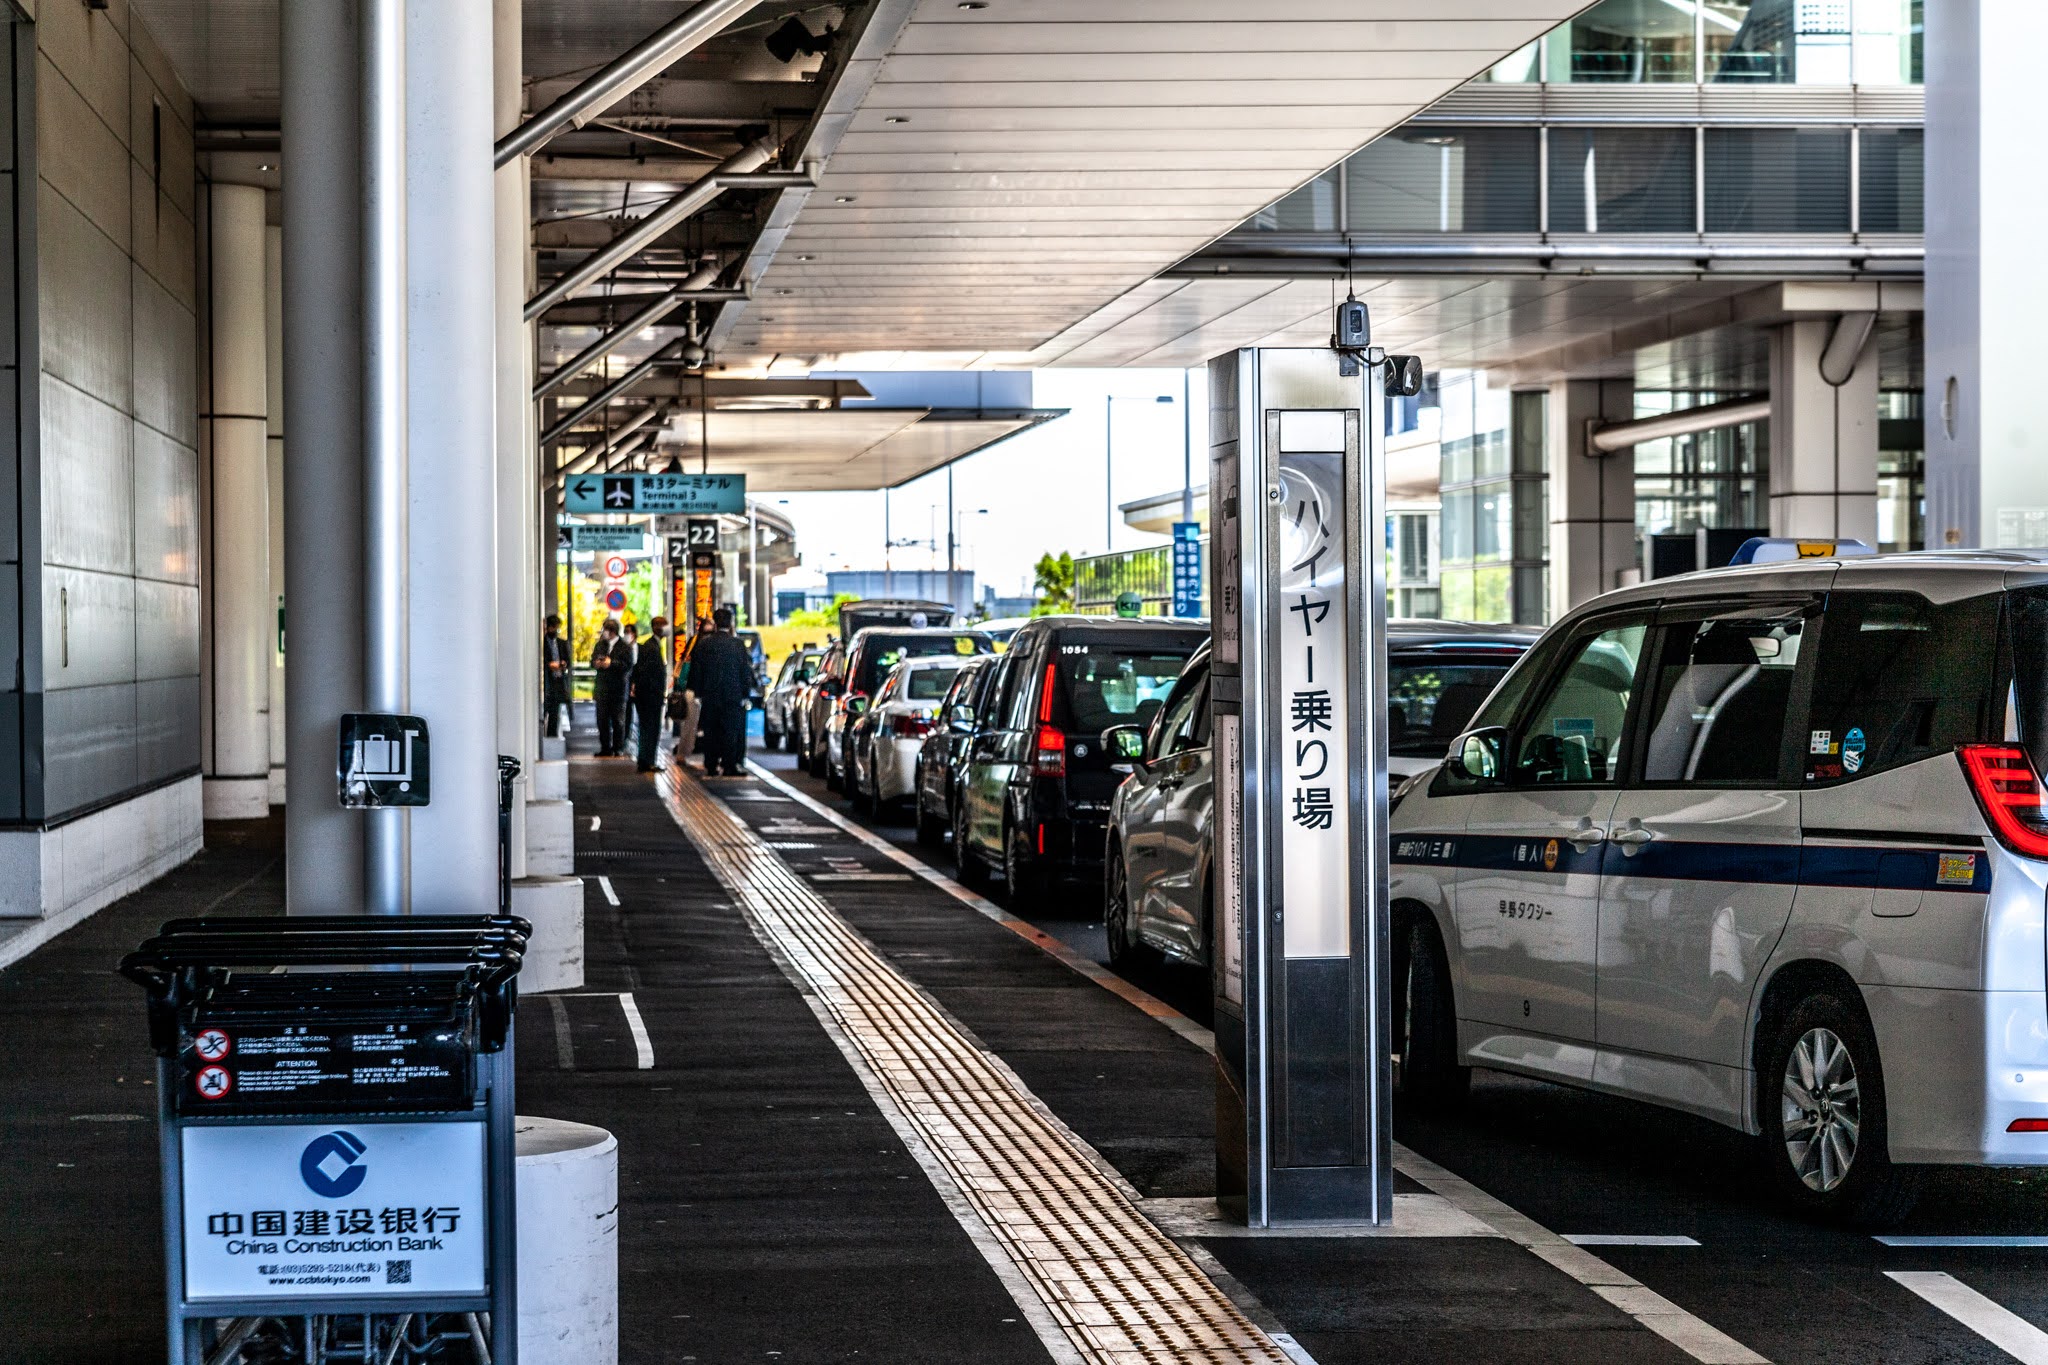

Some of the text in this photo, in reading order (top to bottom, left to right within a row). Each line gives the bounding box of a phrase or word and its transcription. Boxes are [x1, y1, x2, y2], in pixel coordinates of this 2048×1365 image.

[641, 478, 731, 490] 第3ターミナル
[642, 490, 697, 500] Terminal 3
[691, 526, 716, 545] 22
[671, 542, 688, 558] 2
[1062, 646, 1089, 654] 1054
[1290, 500, 1334, 831] ハイヤー乗り場
[1499, 900, 1552, 920] 早野タクシー
[1523, 1001, 1530, 1017] 9
[275, 1060, 318, 1068] ATTENTION
[208, 1207, 461, 1237] 中国建设银行
[226, 1236, 443, 1256] China Construction Bank
[268, 1275, 371, 1285] www.ccbtokyo.com
